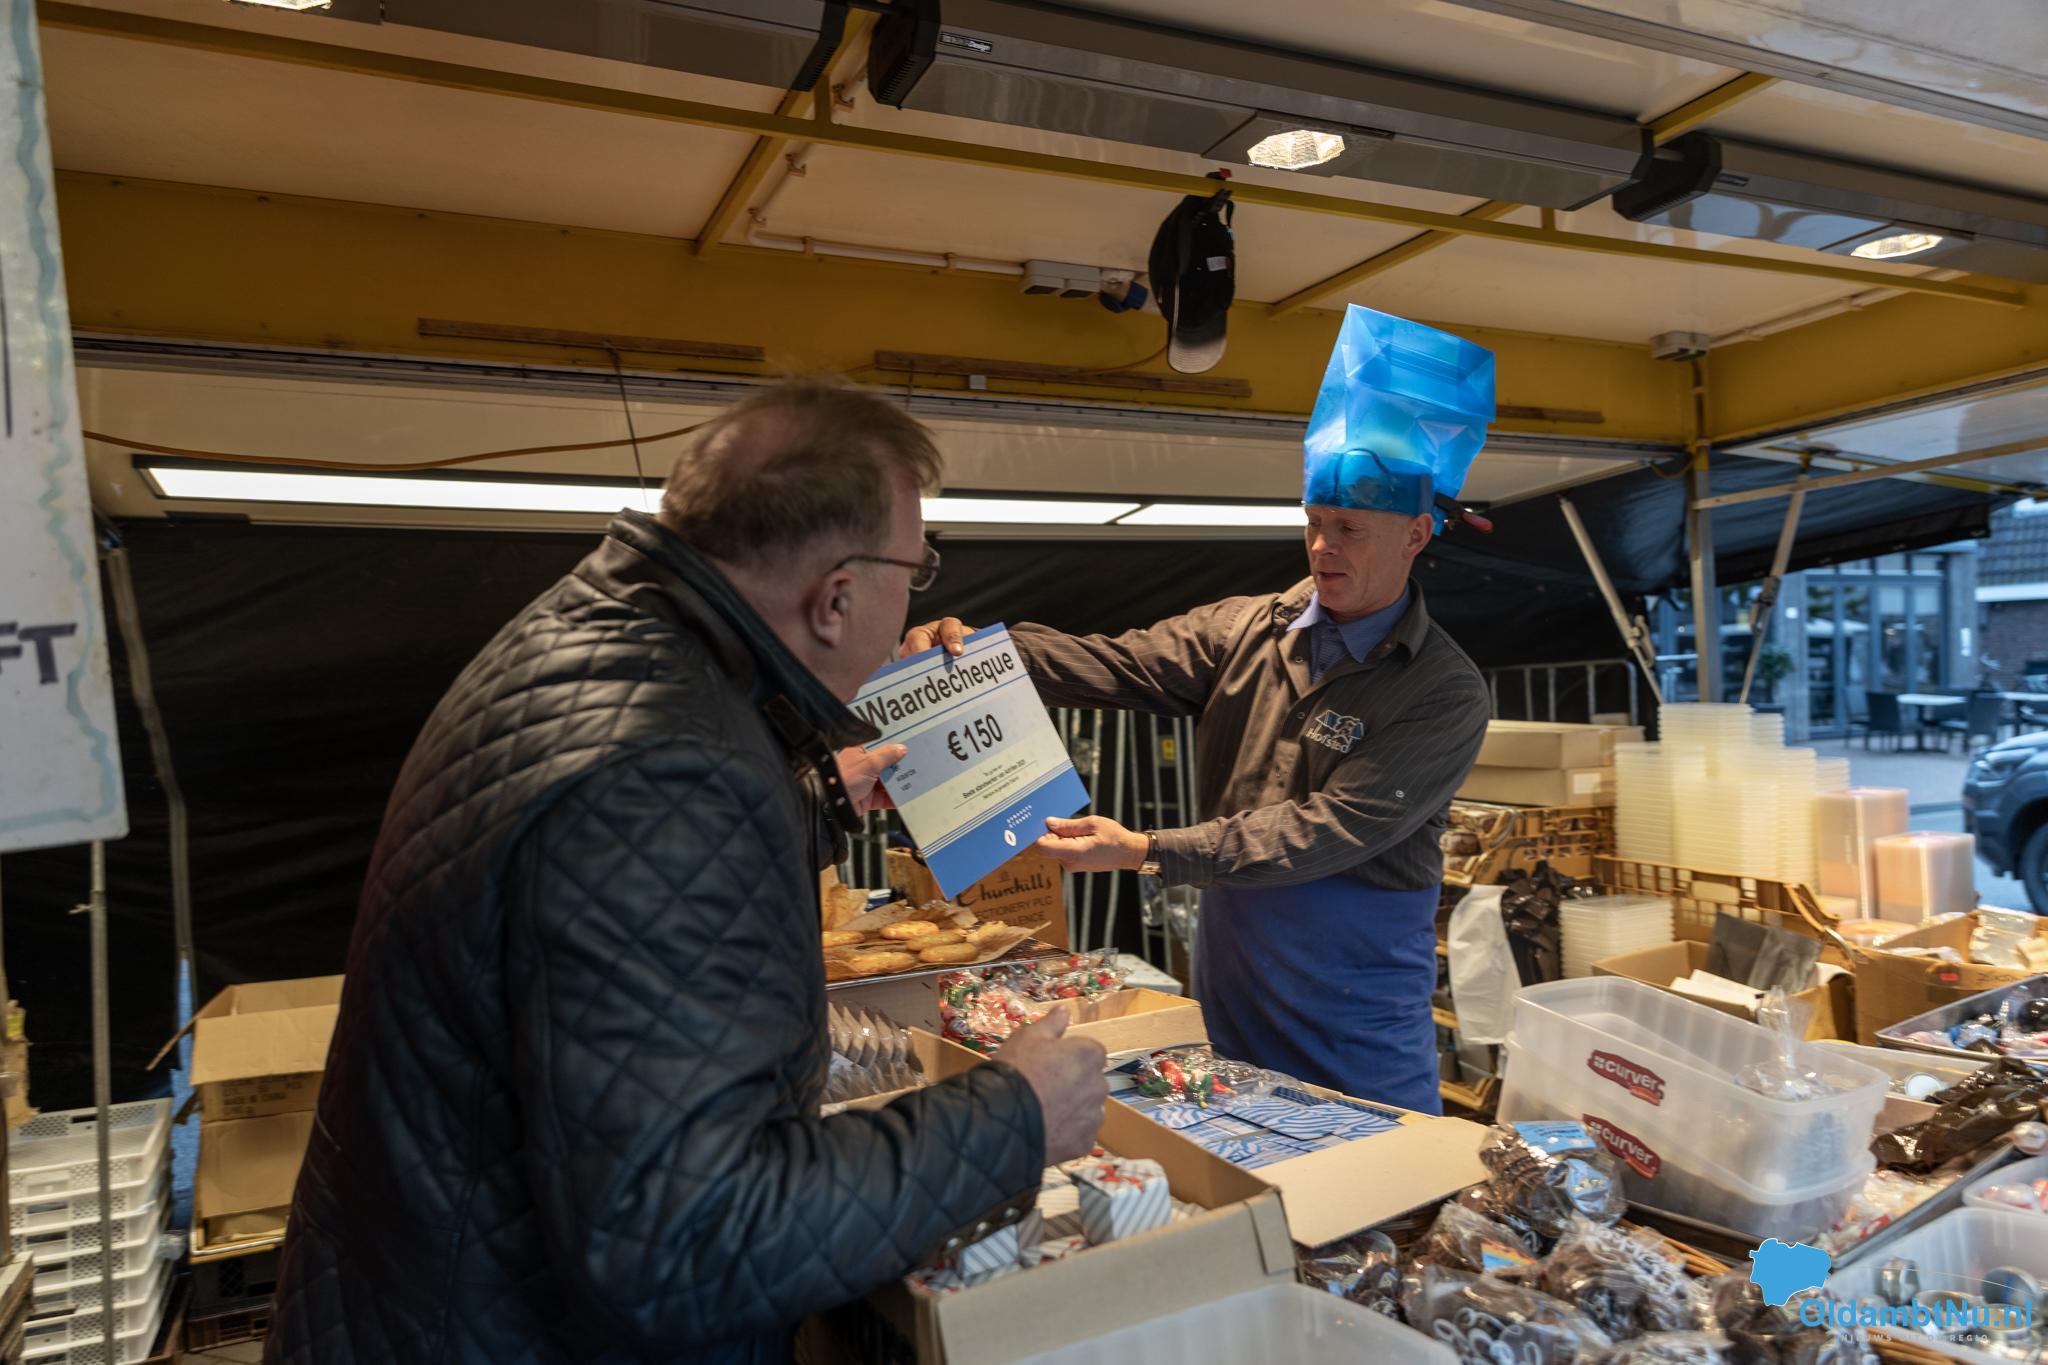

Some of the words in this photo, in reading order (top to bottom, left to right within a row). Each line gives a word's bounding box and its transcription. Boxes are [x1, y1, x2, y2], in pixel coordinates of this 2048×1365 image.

[855, 651, 1014, 729] Waardecheque
[1605, 1060, 1658, 1091] curver
[1602, 1127, 1653, 1165] curver
